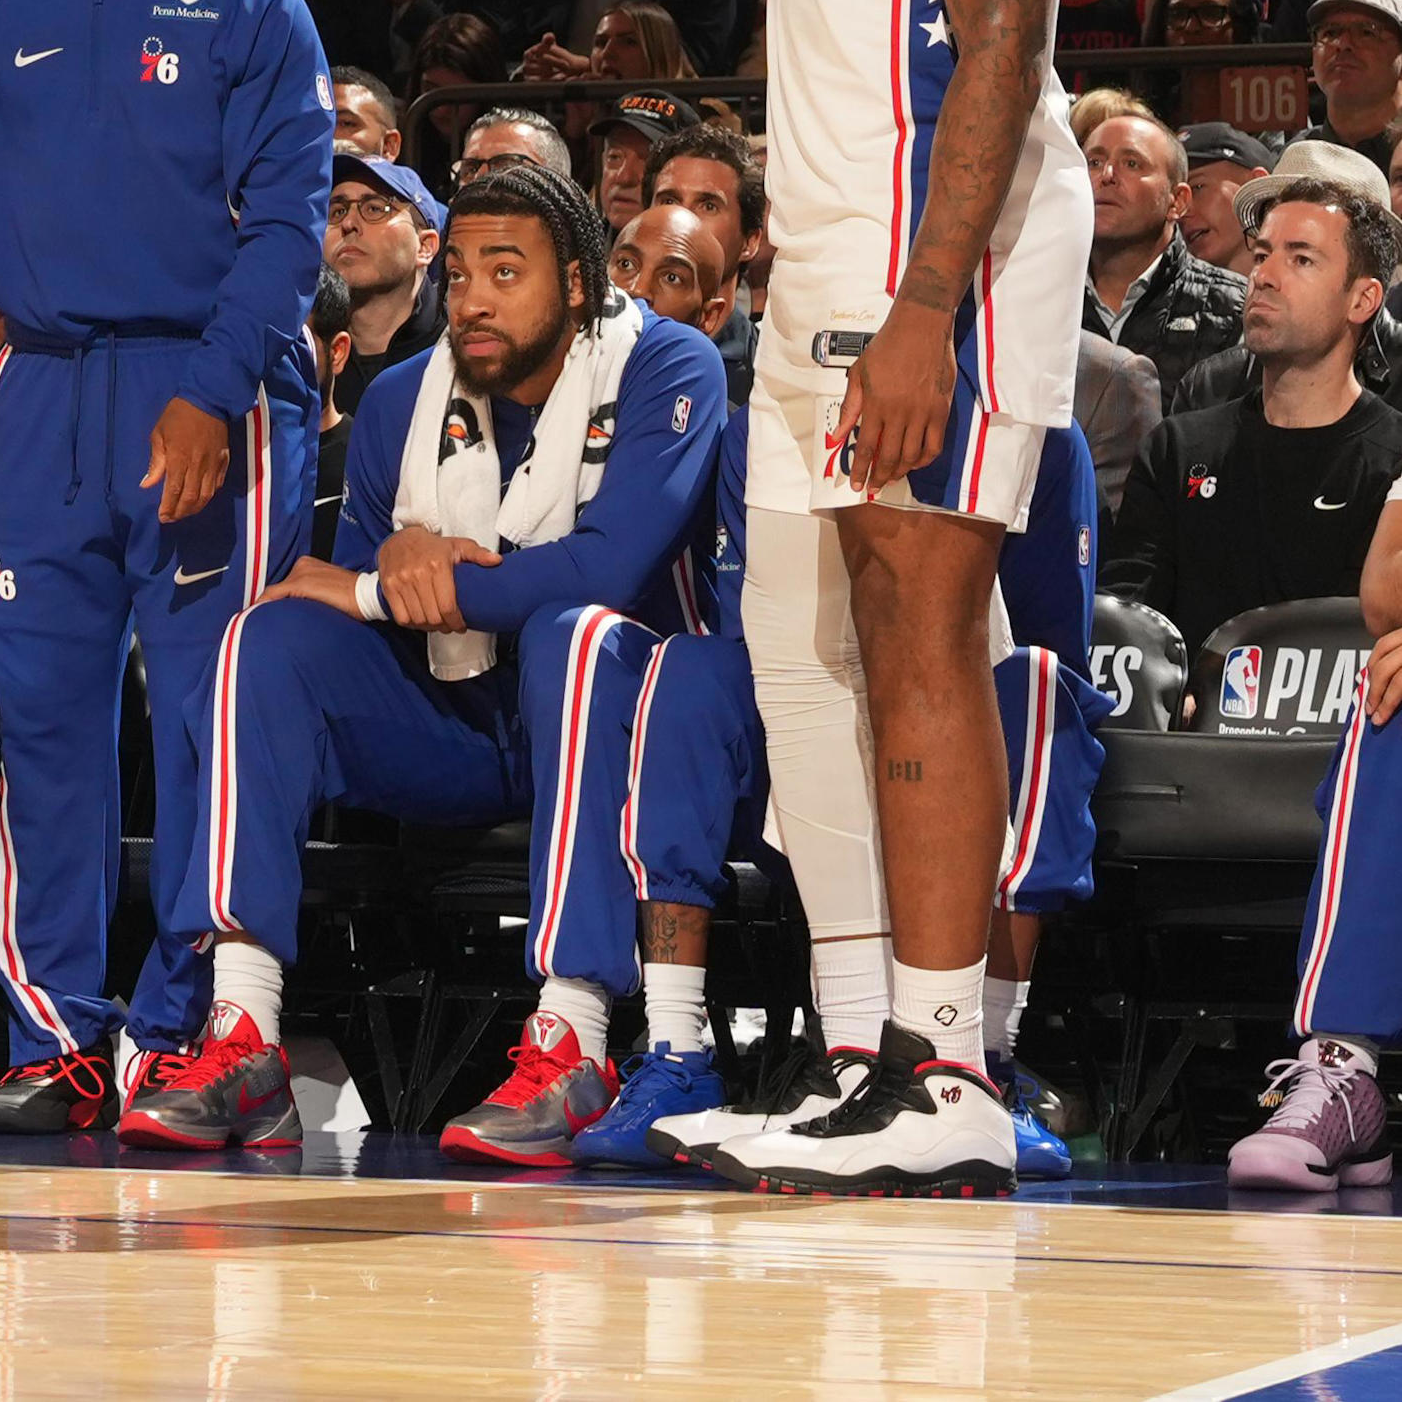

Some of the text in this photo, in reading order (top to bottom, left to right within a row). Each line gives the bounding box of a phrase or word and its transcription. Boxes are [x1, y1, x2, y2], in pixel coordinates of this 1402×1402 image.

[152, 5, 220, 20] Penn Medicine
[619, 96, 675, 117] KNICKS
[1229, 75, 1297, 124] 106
[1224, 697, 1244, 712] NBA
